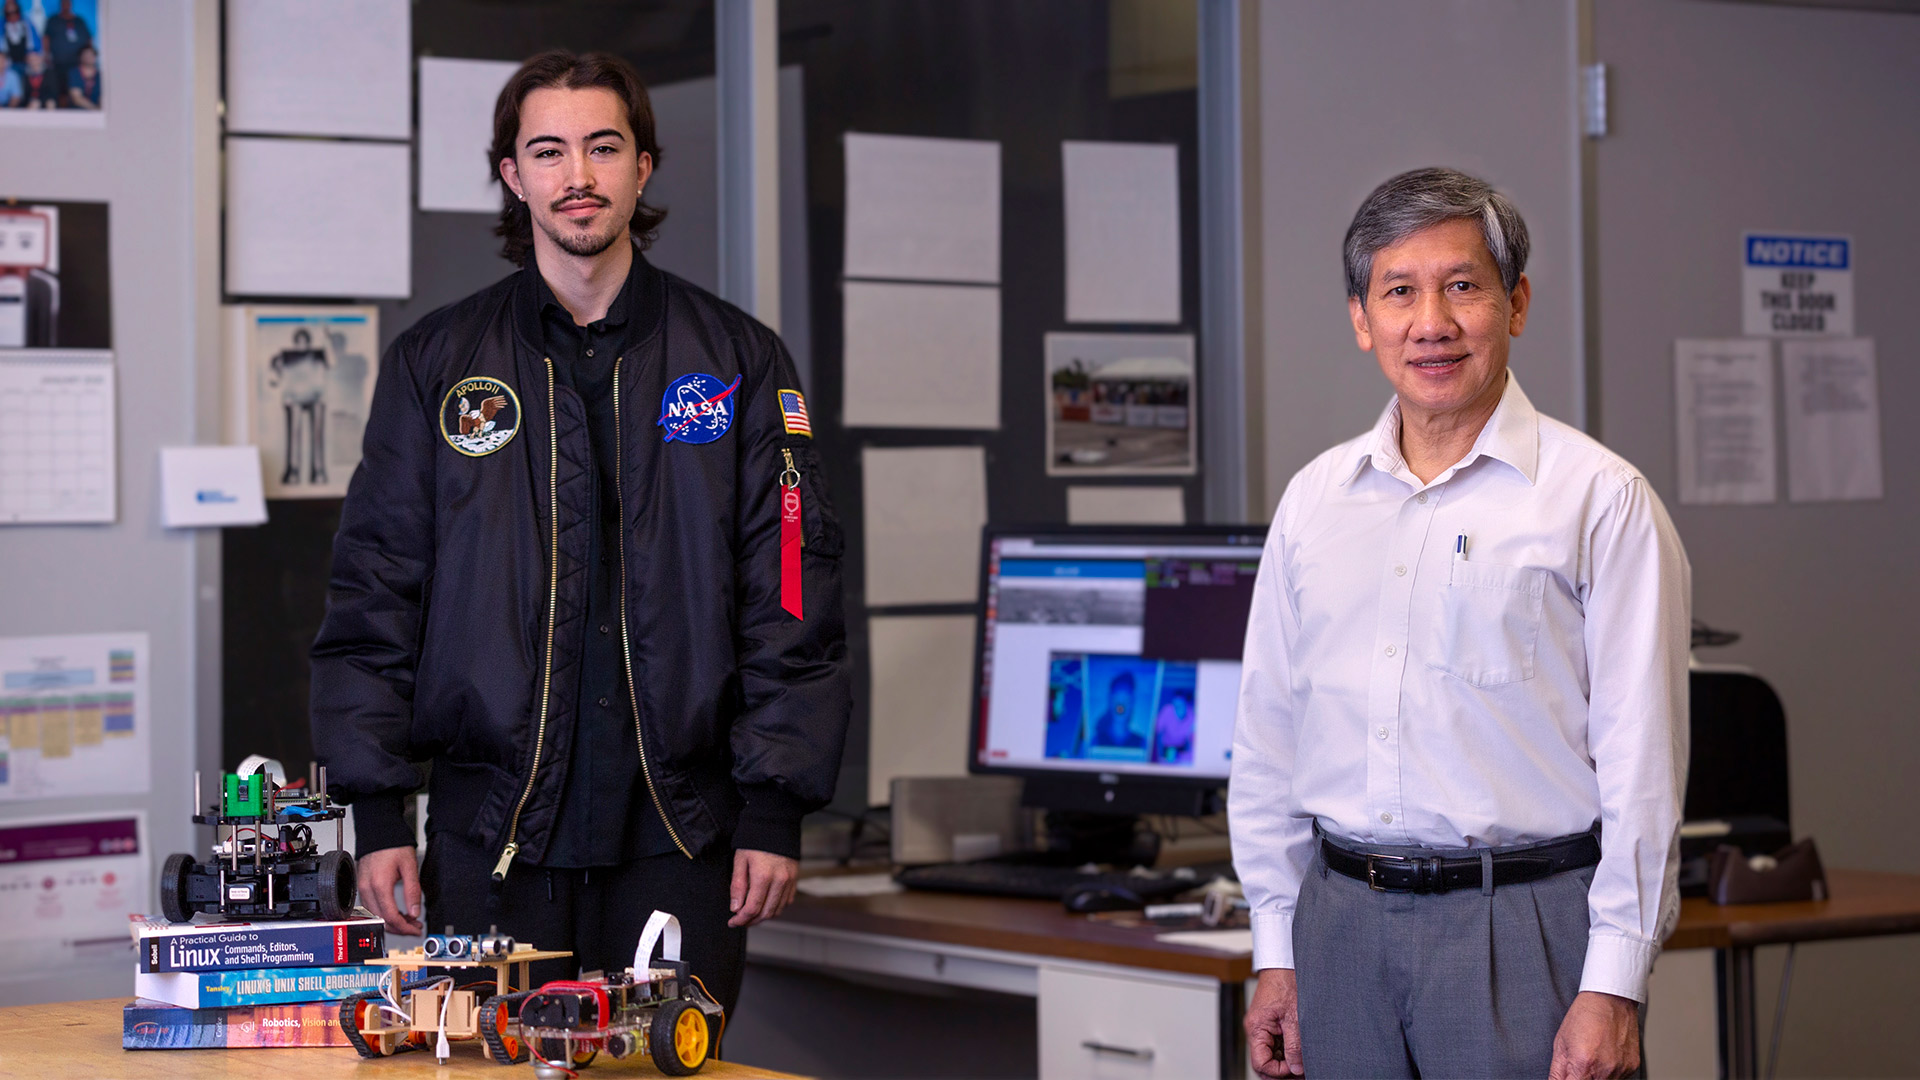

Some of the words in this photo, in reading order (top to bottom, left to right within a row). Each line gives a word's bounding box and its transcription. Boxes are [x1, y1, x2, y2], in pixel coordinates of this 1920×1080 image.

[1752, 241, 1844, 265] NOTICE
[1781, 272, 1815, 289] KEEP
[1761, 291, 1791, 310] THIS
[1798, 293, 1835, 311] DOOR
[1772, 312, 1825, 332] CLOSED
[668, 401, 729, 418] NASA
[170, 937, 178, 945] A
[179, 935, 217, 945] Practical
[218, 933, 247, 942] Guide
[248, 933, 259, 941] to
[170, 945, 221, 968] Linux
[224, 943, 268, 954] Commands,
[269, 942, 299, 952] Editors,
[224, 954, 240, 965] and
[240, 953, 260, 964] Shell
[262, 951, 314, 965] Programming
[205, 985, 230, 993] Tansley
[236, 979, 263, 995] LINUX
[273, 977, 296, 994] UNIX
[298, 976, 323, 991] SHELL
[262, 1017, 300, 1028] Robotics,
[302, 1017, 326, 1027] Vision
